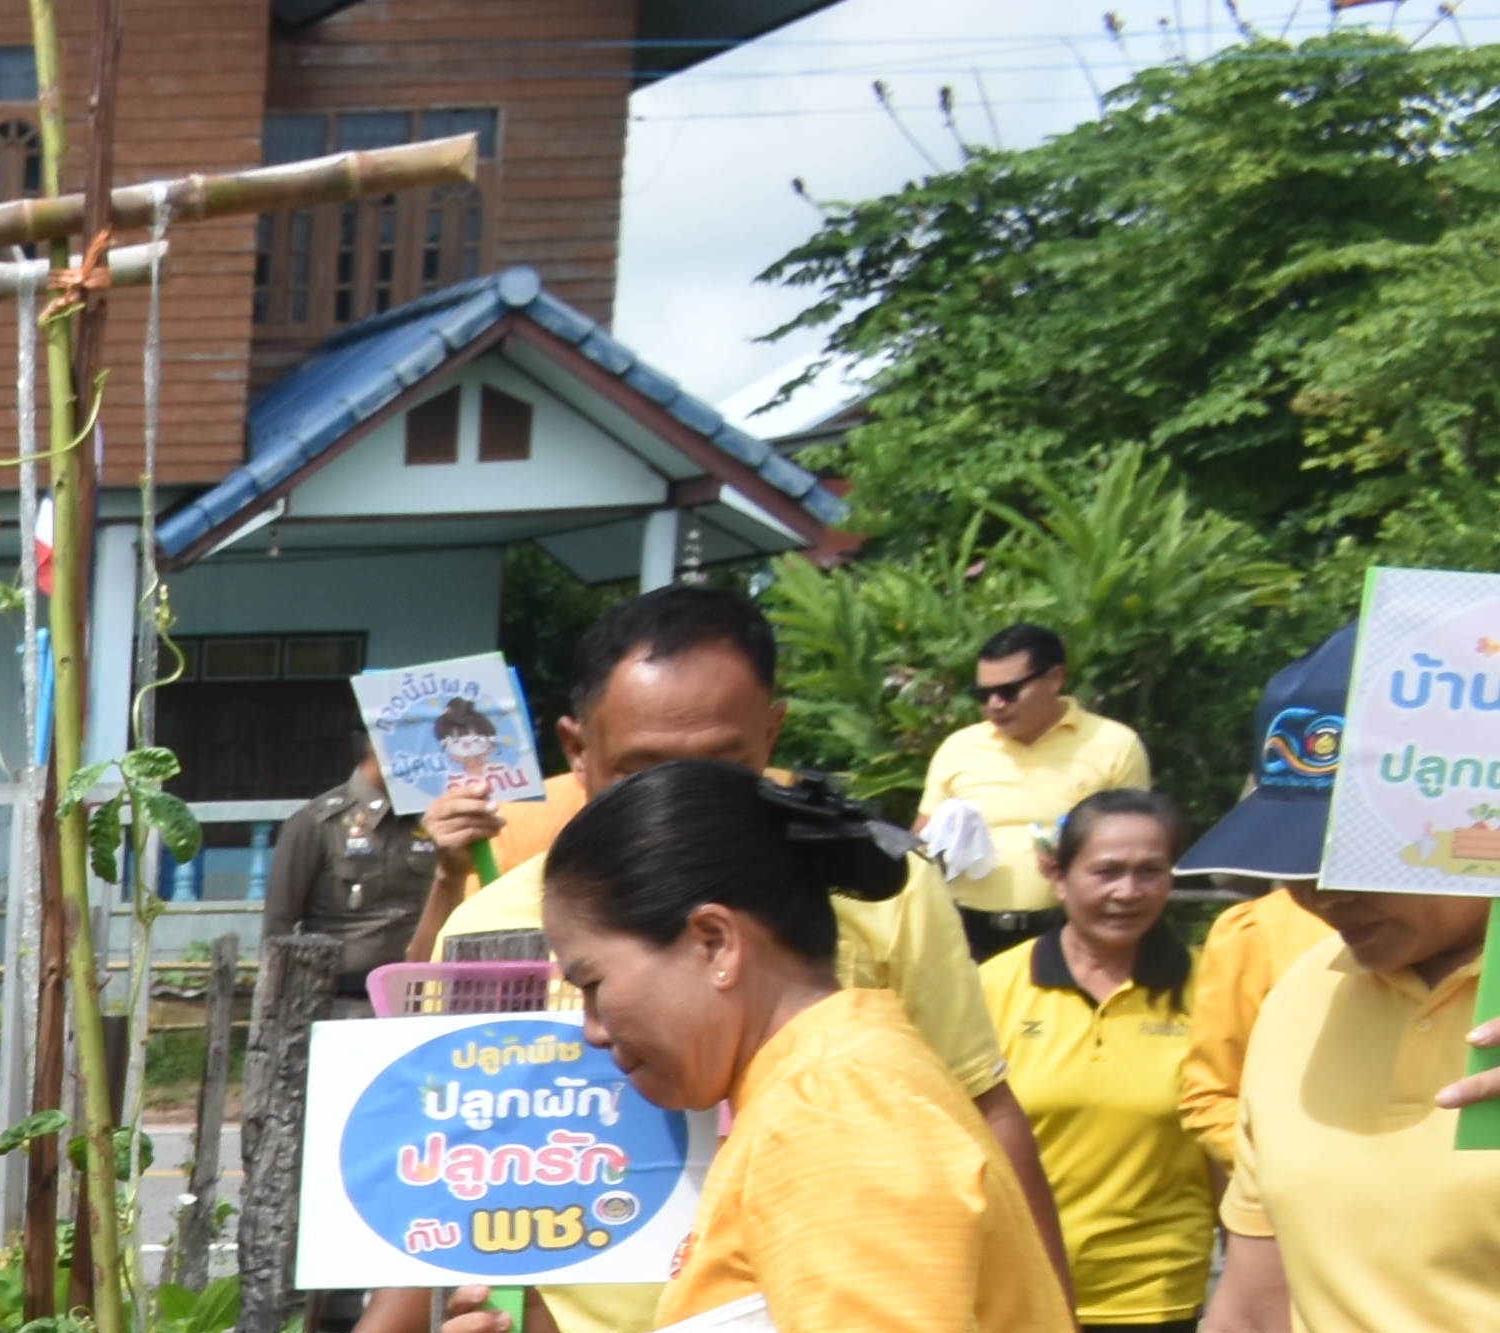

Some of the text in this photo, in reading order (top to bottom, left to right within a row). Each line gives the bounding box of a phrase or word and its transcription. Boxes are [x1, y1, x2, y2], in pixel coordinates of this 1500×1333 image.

[452, 1034, 582, 1075] ปลูกพืช
[424, 1076, 618, 1130] ปลูกผัก
[398, 1129, 628, 1200] ปลูกรัก
[404, 1204, 611, 1254] กับ พช.
